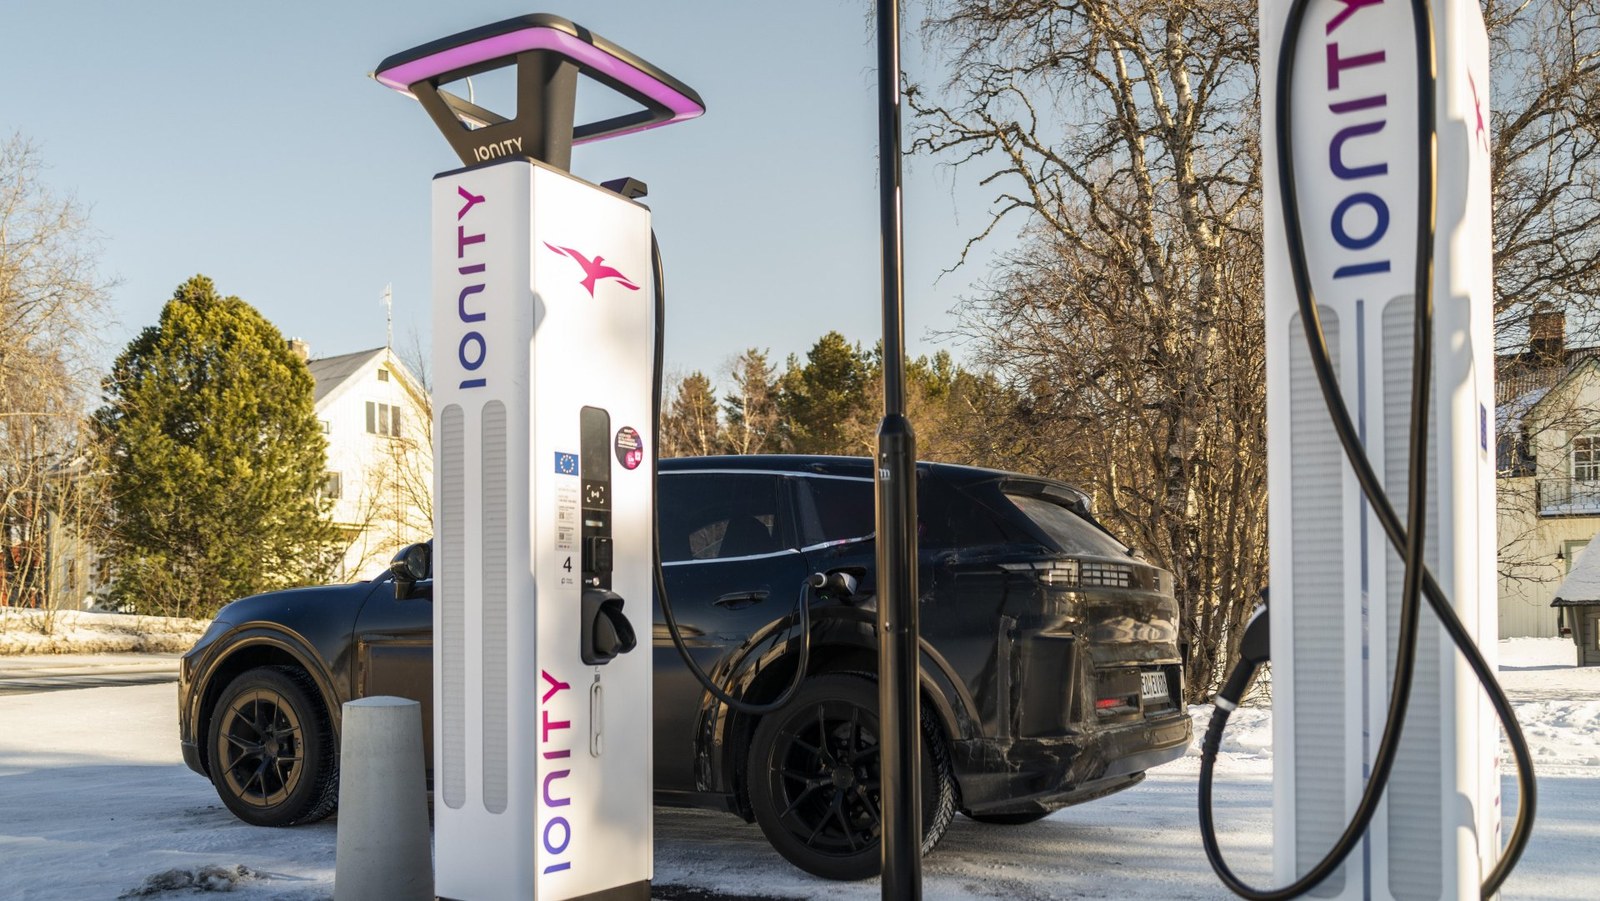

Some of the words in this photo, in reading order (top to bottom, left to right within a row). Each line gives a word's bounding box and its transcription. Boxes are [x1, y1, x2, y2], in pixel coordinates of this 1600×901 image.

[473, 136, 522, 162] IONITY
[1326, 0, 1391, 280] IONITY
[458, 185, 487, 389] IONITY
[563, 556, 572, 573] 4
[542, 669, 571, 875] IONITY
